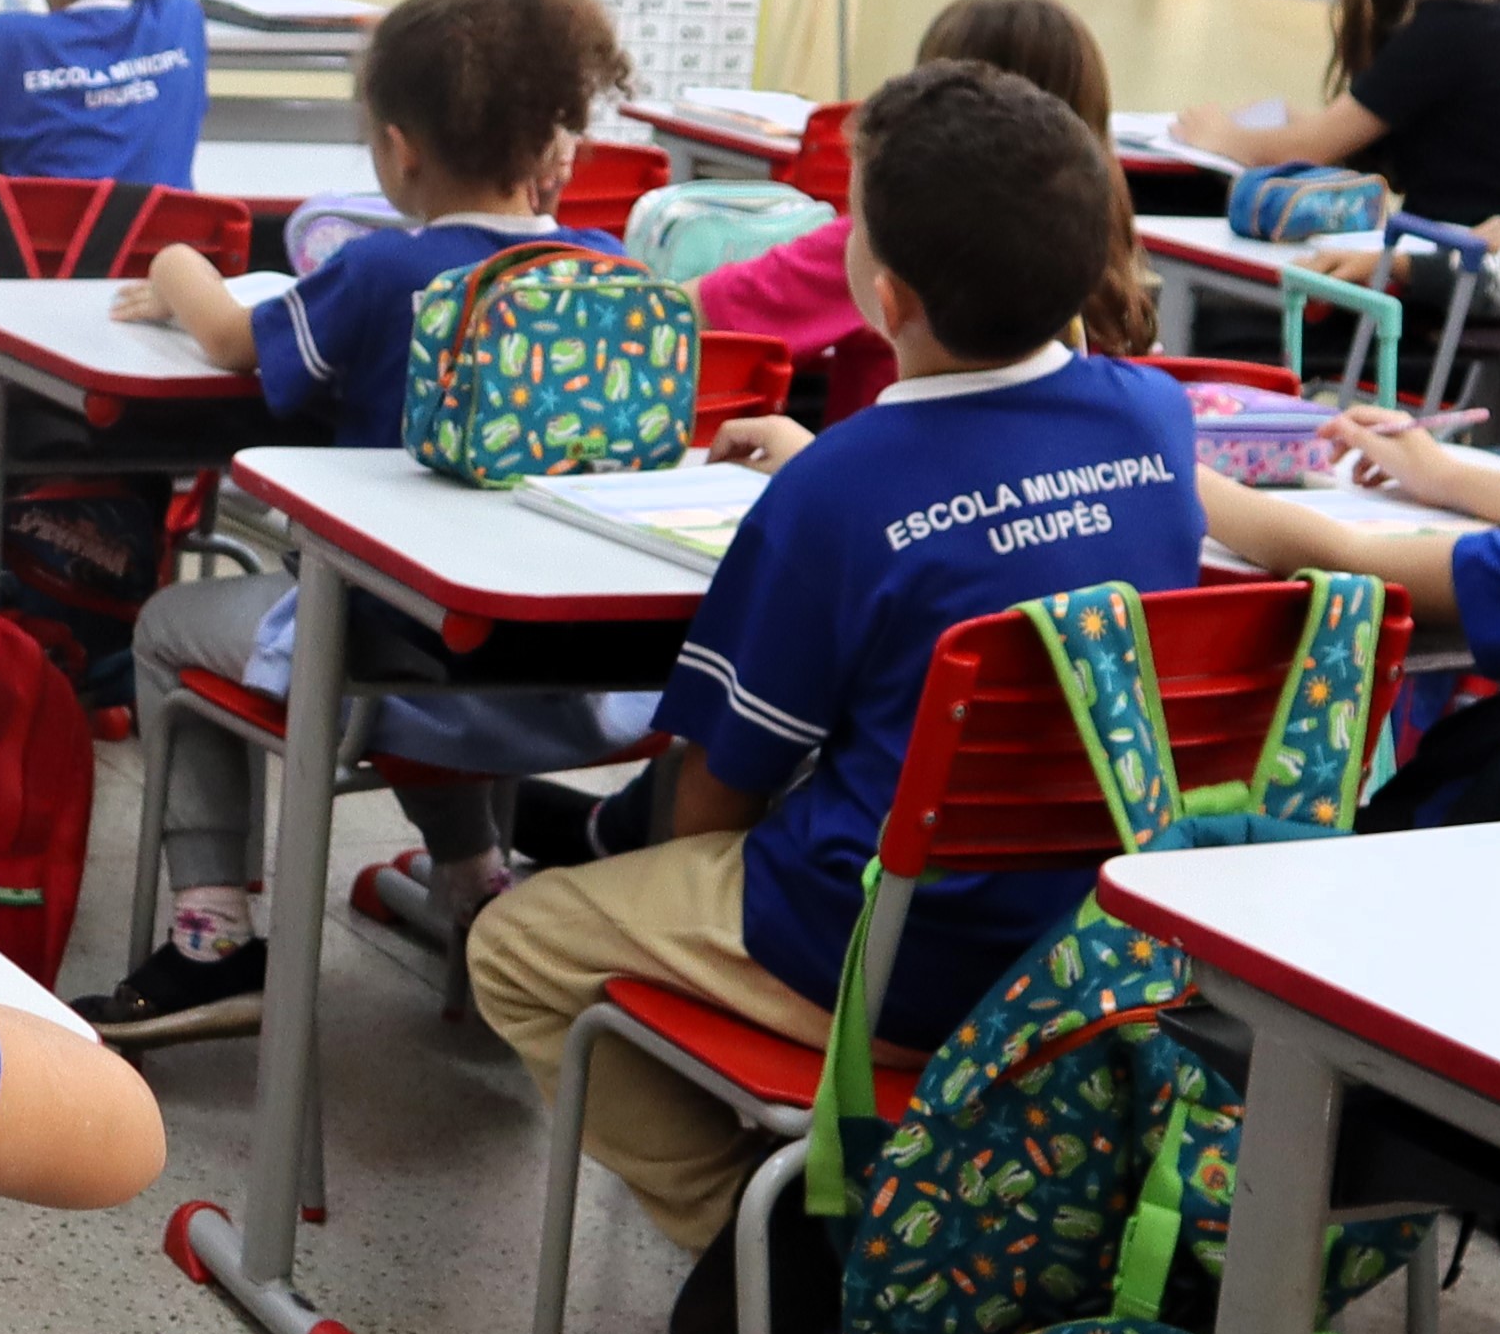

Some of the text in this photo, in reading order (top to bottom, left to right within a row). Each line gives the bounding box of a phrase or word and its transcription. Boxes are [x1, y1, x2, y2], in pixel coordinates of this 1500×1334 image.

[22, 66, 110, 93] ESCOLA
[886, 453, 1175, 552] ESCOLA MUNICIPAL
[988, 501, 1114, 555] URUPÊS
